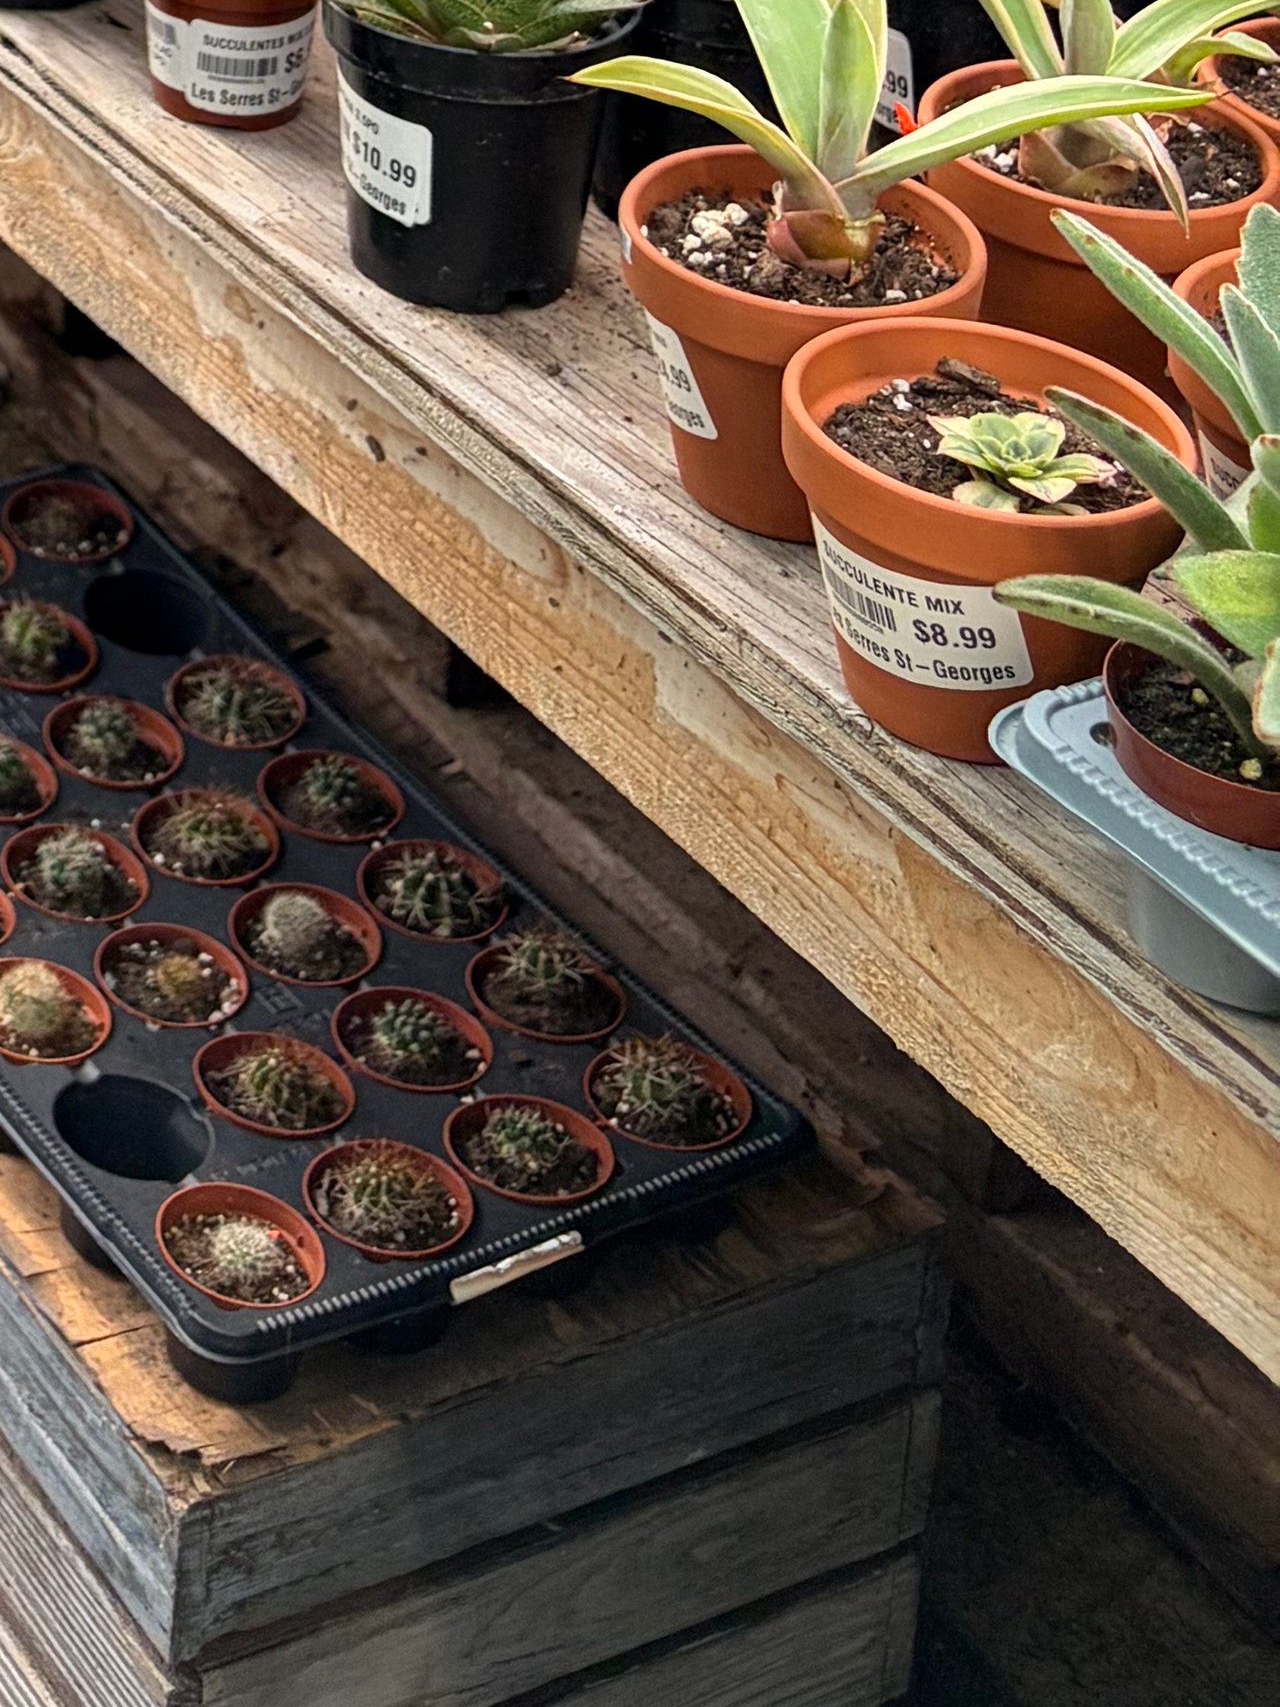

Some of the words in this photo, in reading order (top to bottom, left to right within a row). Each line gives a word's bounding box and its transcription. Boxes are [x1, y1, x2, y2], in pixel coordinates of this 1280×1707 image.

[191, 82, 215, 103] Les
[219, 88, 266, 106] Serres
[352, 130, 416, 189] $10.99
[823, 540, 920, 608] SUCCULENTE
[925, 595, 966, 616] MIX
[844, 617, 890, 663] Serres
[912, 617, 997, 650] $8.99
